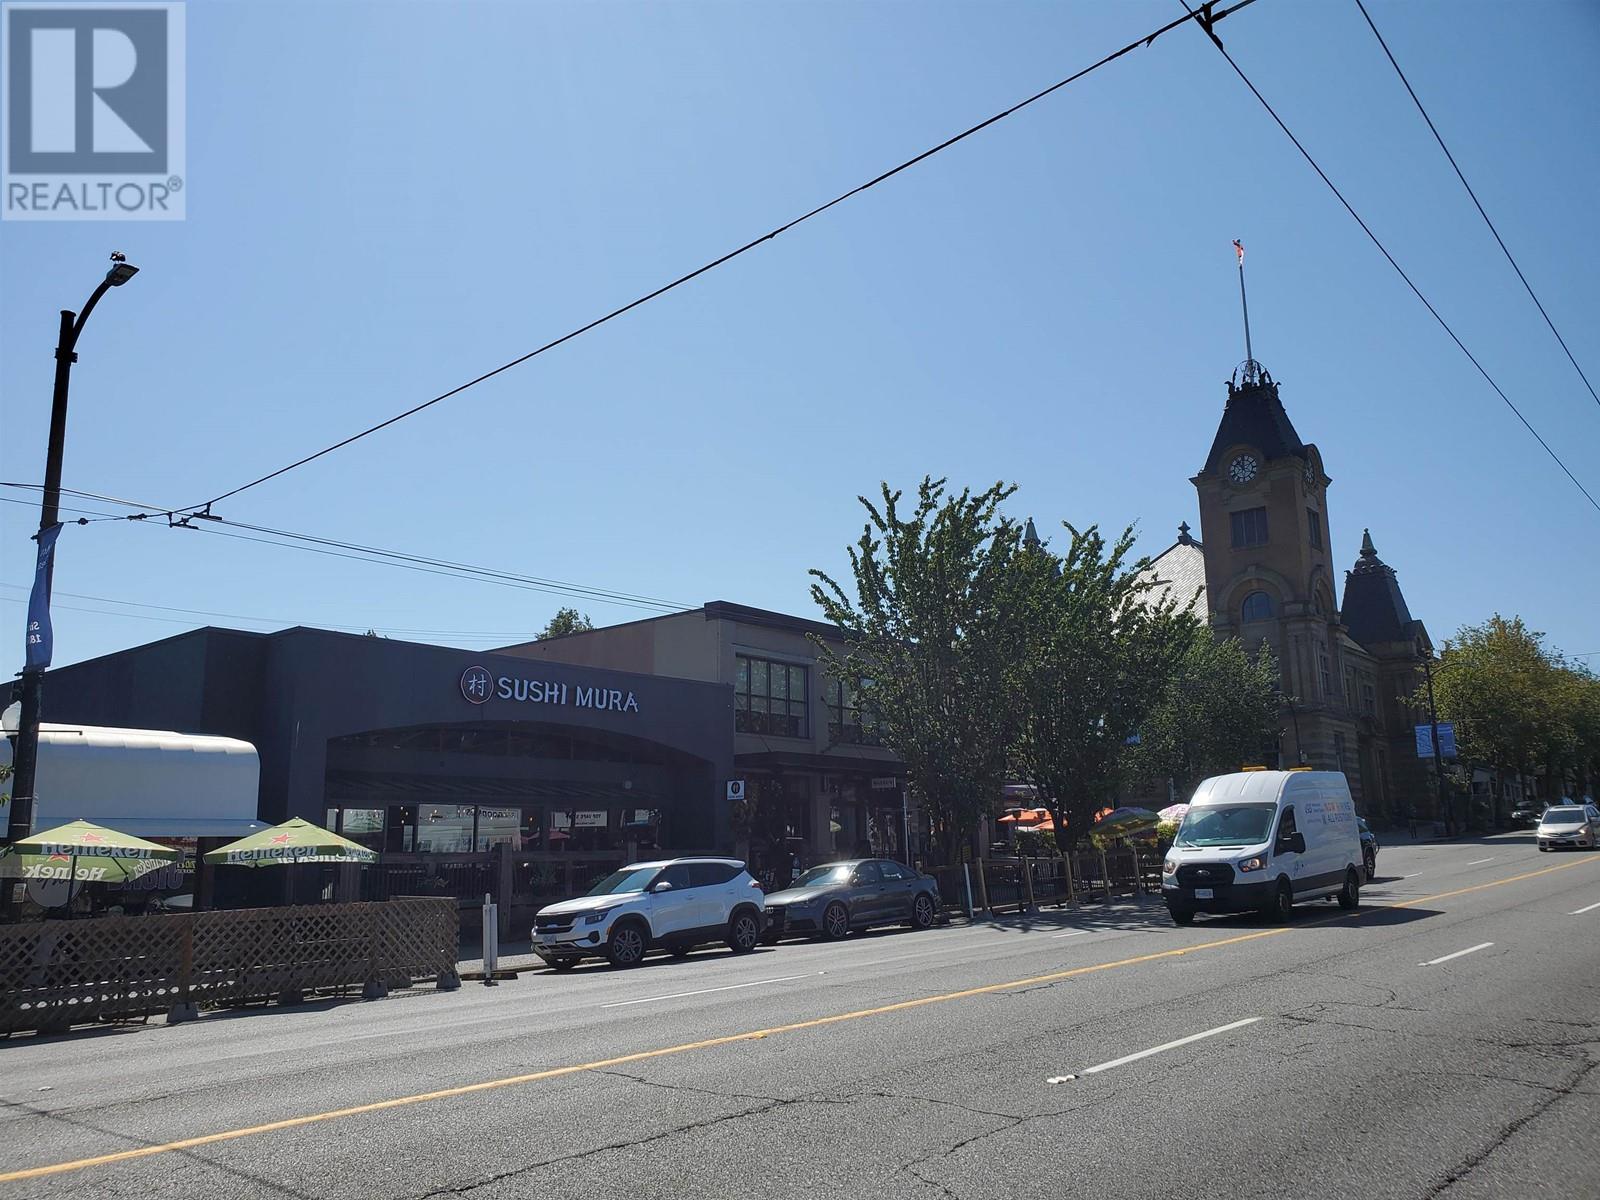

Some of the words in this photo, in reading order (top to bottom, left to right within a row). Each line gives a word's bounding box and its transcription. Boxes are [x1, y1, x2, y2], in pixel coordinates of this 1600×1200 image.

[467, 673, 488, 698] 村
[497, 676, 568, 705] SUSHI
[575, 685, 640, 713] MURA
[40, 843, 152, 859] Heineken
[227, 845, 317, 863] Heineken
